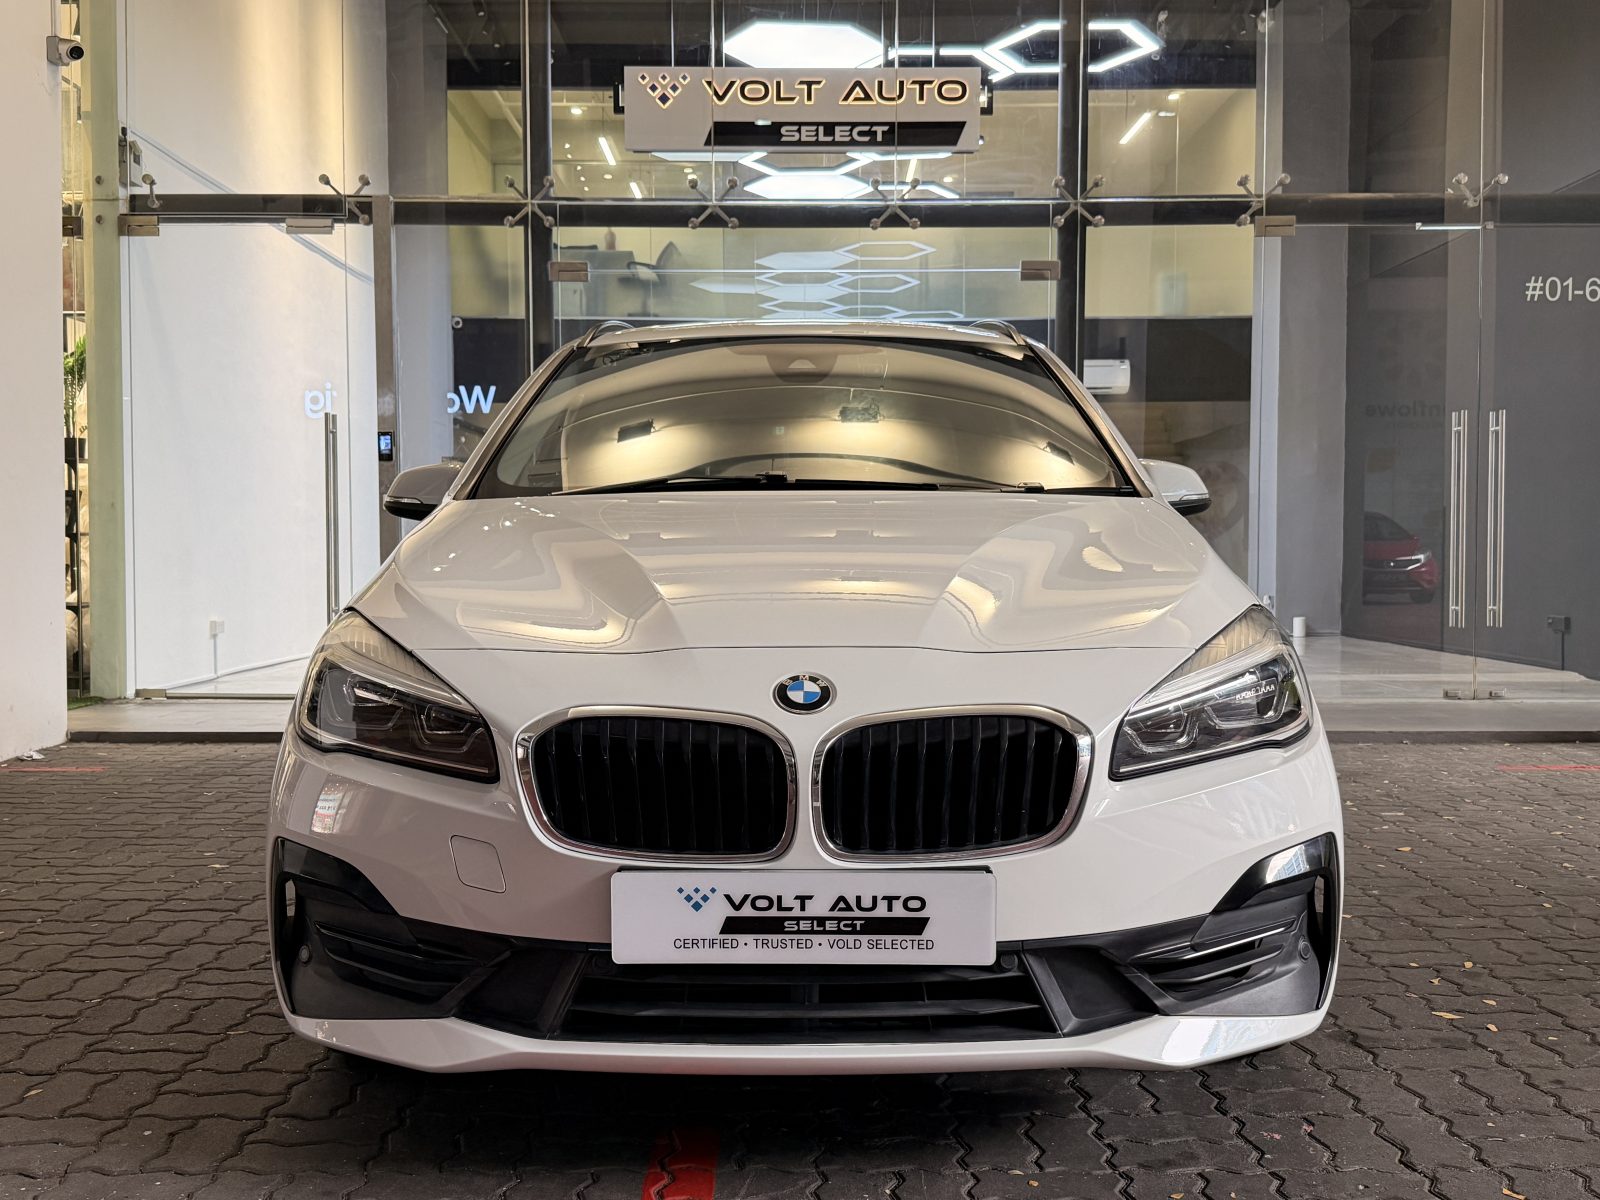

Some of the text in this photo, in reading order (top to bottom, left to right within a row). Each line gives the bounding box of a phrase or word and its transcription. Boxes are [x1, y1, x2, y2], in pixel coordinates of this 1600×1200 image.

[703, 79, 969, 105] VOLT AUTO
[780, 125, 890, 142] SELECT
[1525, 276, 1600, 302] #01-6
[723, 894, 927, 913] VOLT AUTO
[783, 920, 866, 931] SELECT
[673, 938, 935, 951] CERTIFIED TRUSTED VOLD SELECTED
